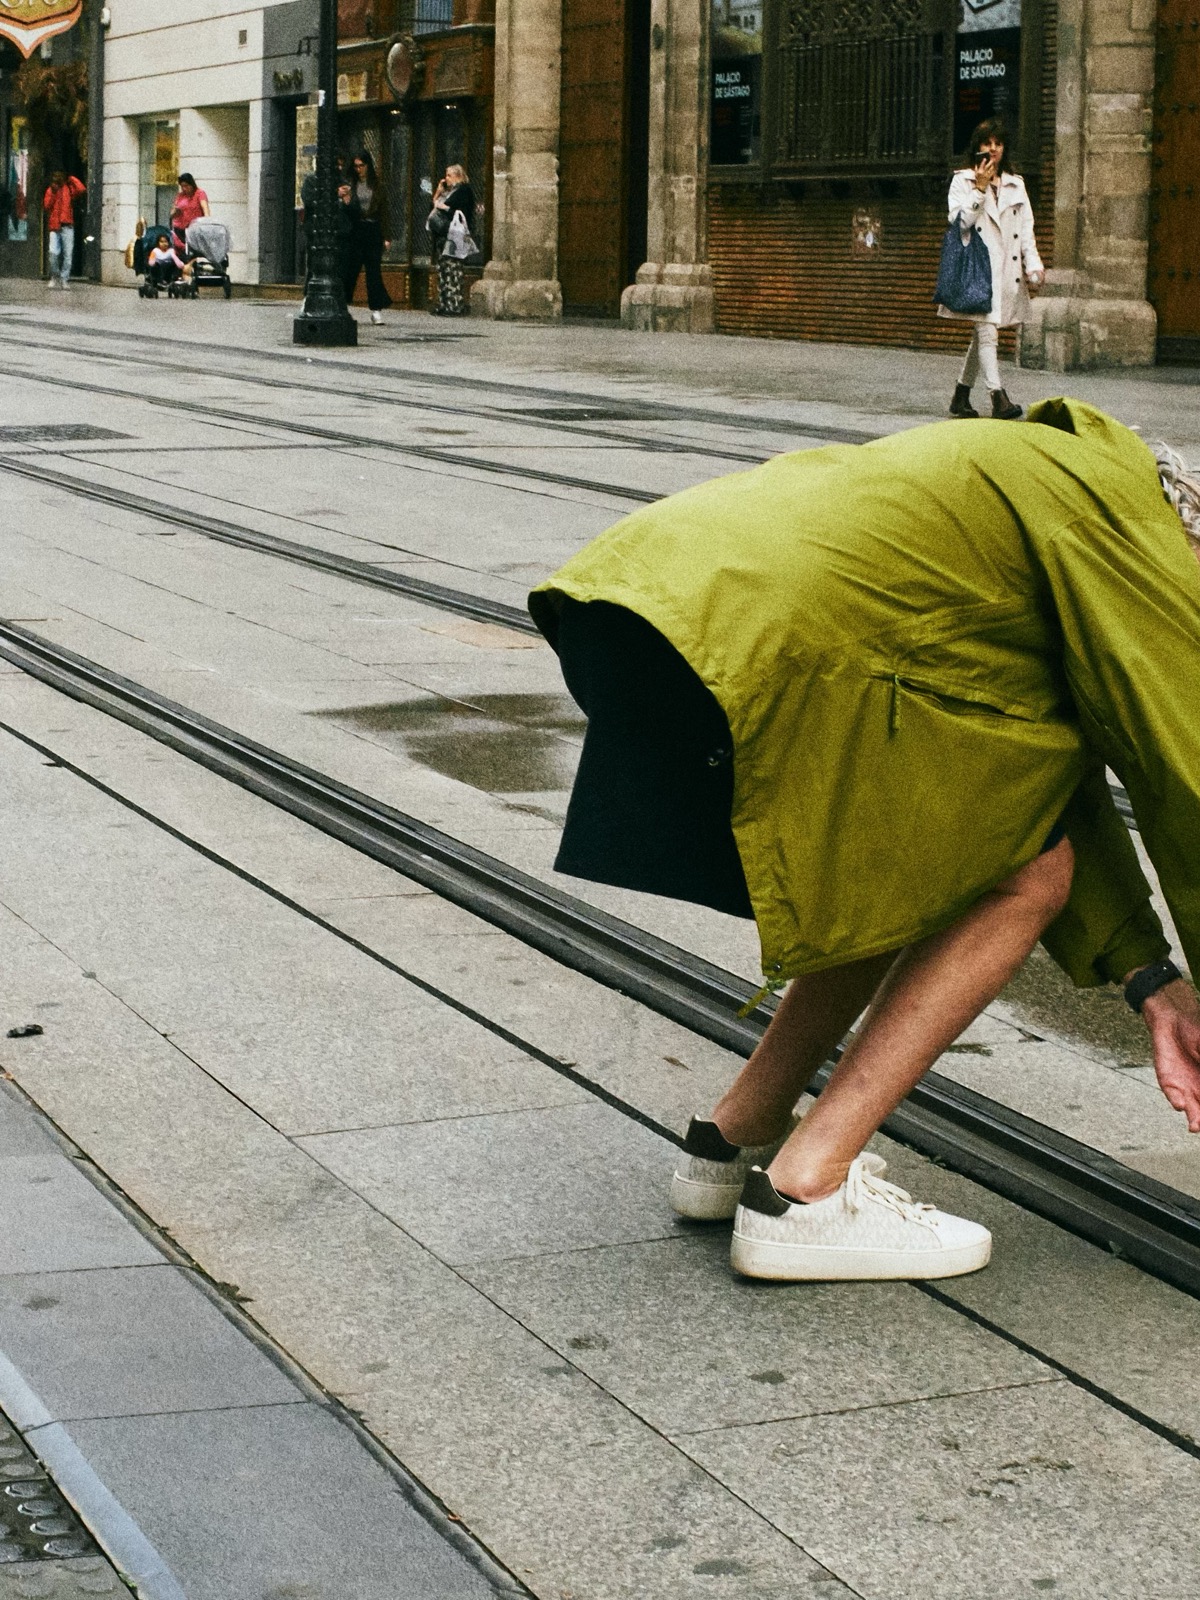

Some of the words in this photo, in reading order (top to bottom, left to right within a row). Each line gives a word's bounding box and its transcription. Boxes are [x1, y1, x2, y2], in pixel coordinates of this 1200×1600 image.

[960, 48, 993, 63] PALACIO
[715, 71, 741, 84] PALACIO
[960, 67, 970, 80] DE
[971, 62, 1006, 79] SÁSTAGO
[715, 87, 723, 99] DE
